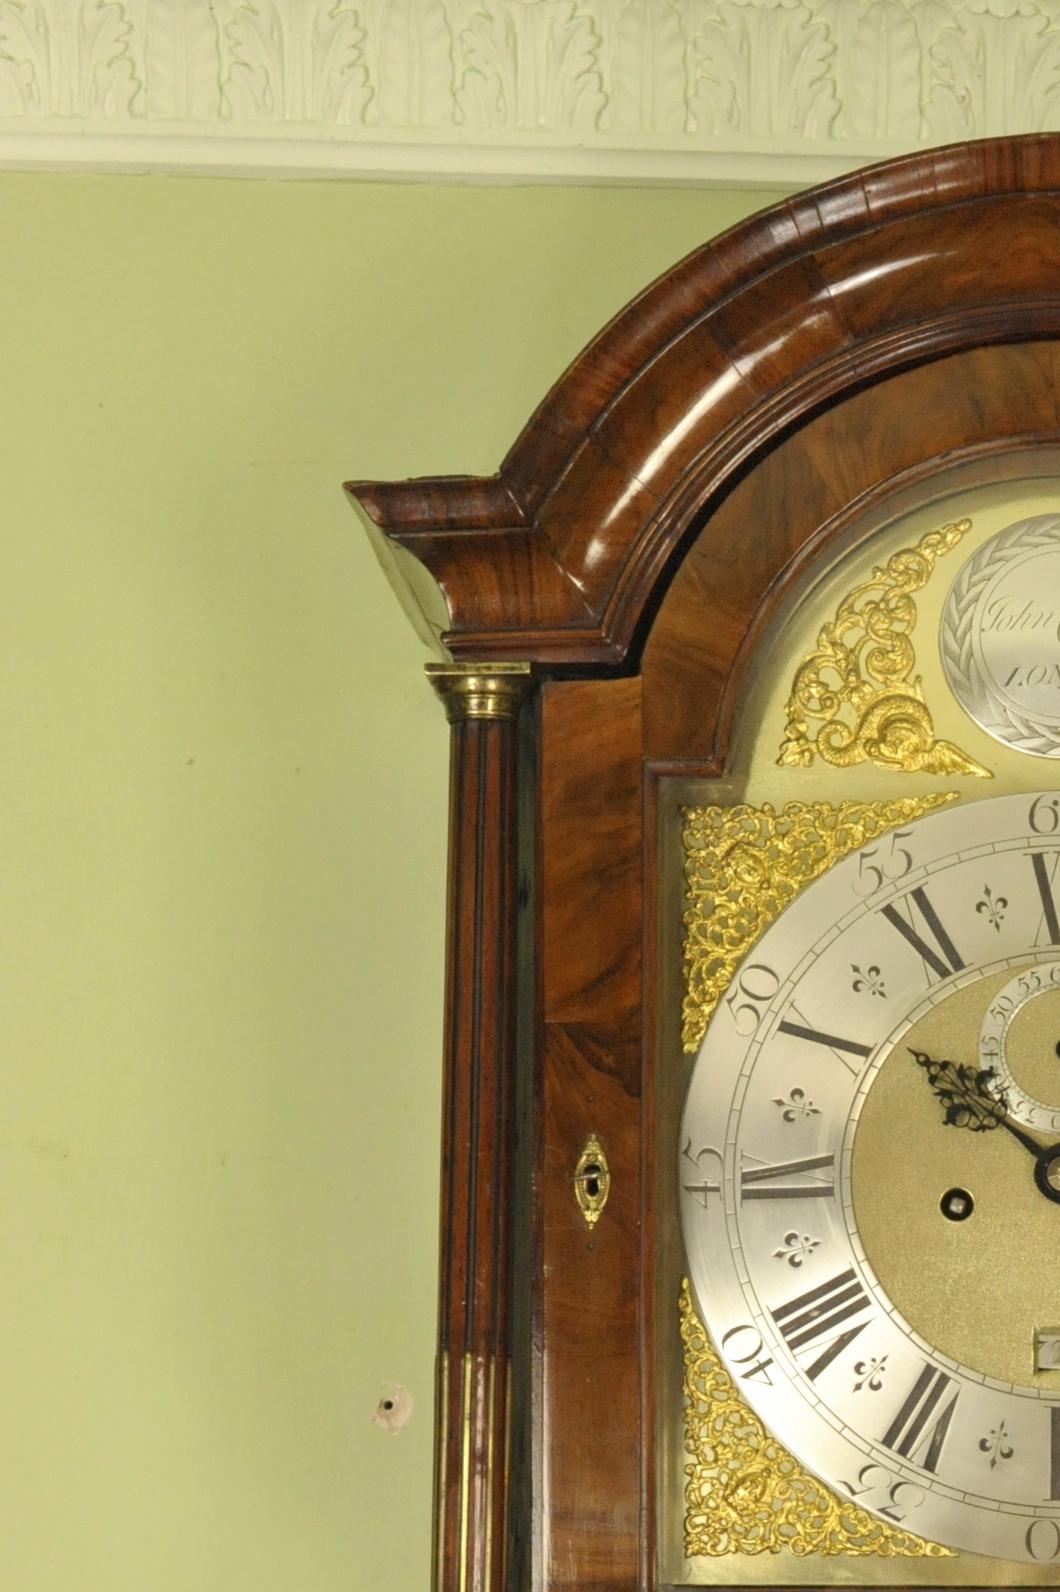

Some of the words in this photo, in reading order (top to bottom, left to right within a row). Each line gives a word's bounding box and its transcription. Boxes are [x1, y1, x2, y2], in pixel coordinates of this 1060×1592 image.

[981, 595, 1054, 632] John
[850, 831, 914, 897] 55
[875, 882, 974, 990] XI
[726, 963, 779, 1037] 50
[990, 995, 1014, 1021] 50
[1018, 971, 1042, 993] 55
[771, 1000, 877, 1078] X
[981, 1036, 999, 1062] 45
[1012, 1100, 1037, 1124] 35
[682, 1137, 722, 1208] 45
[740, 1149, 835, 1205] IX
[766, 1262, 875, 1384] VIII
[721, 1324, 776, 1388] 40
[874, 1357, 961, 1476] VII
[836, 1463, 925, 1522] 35
